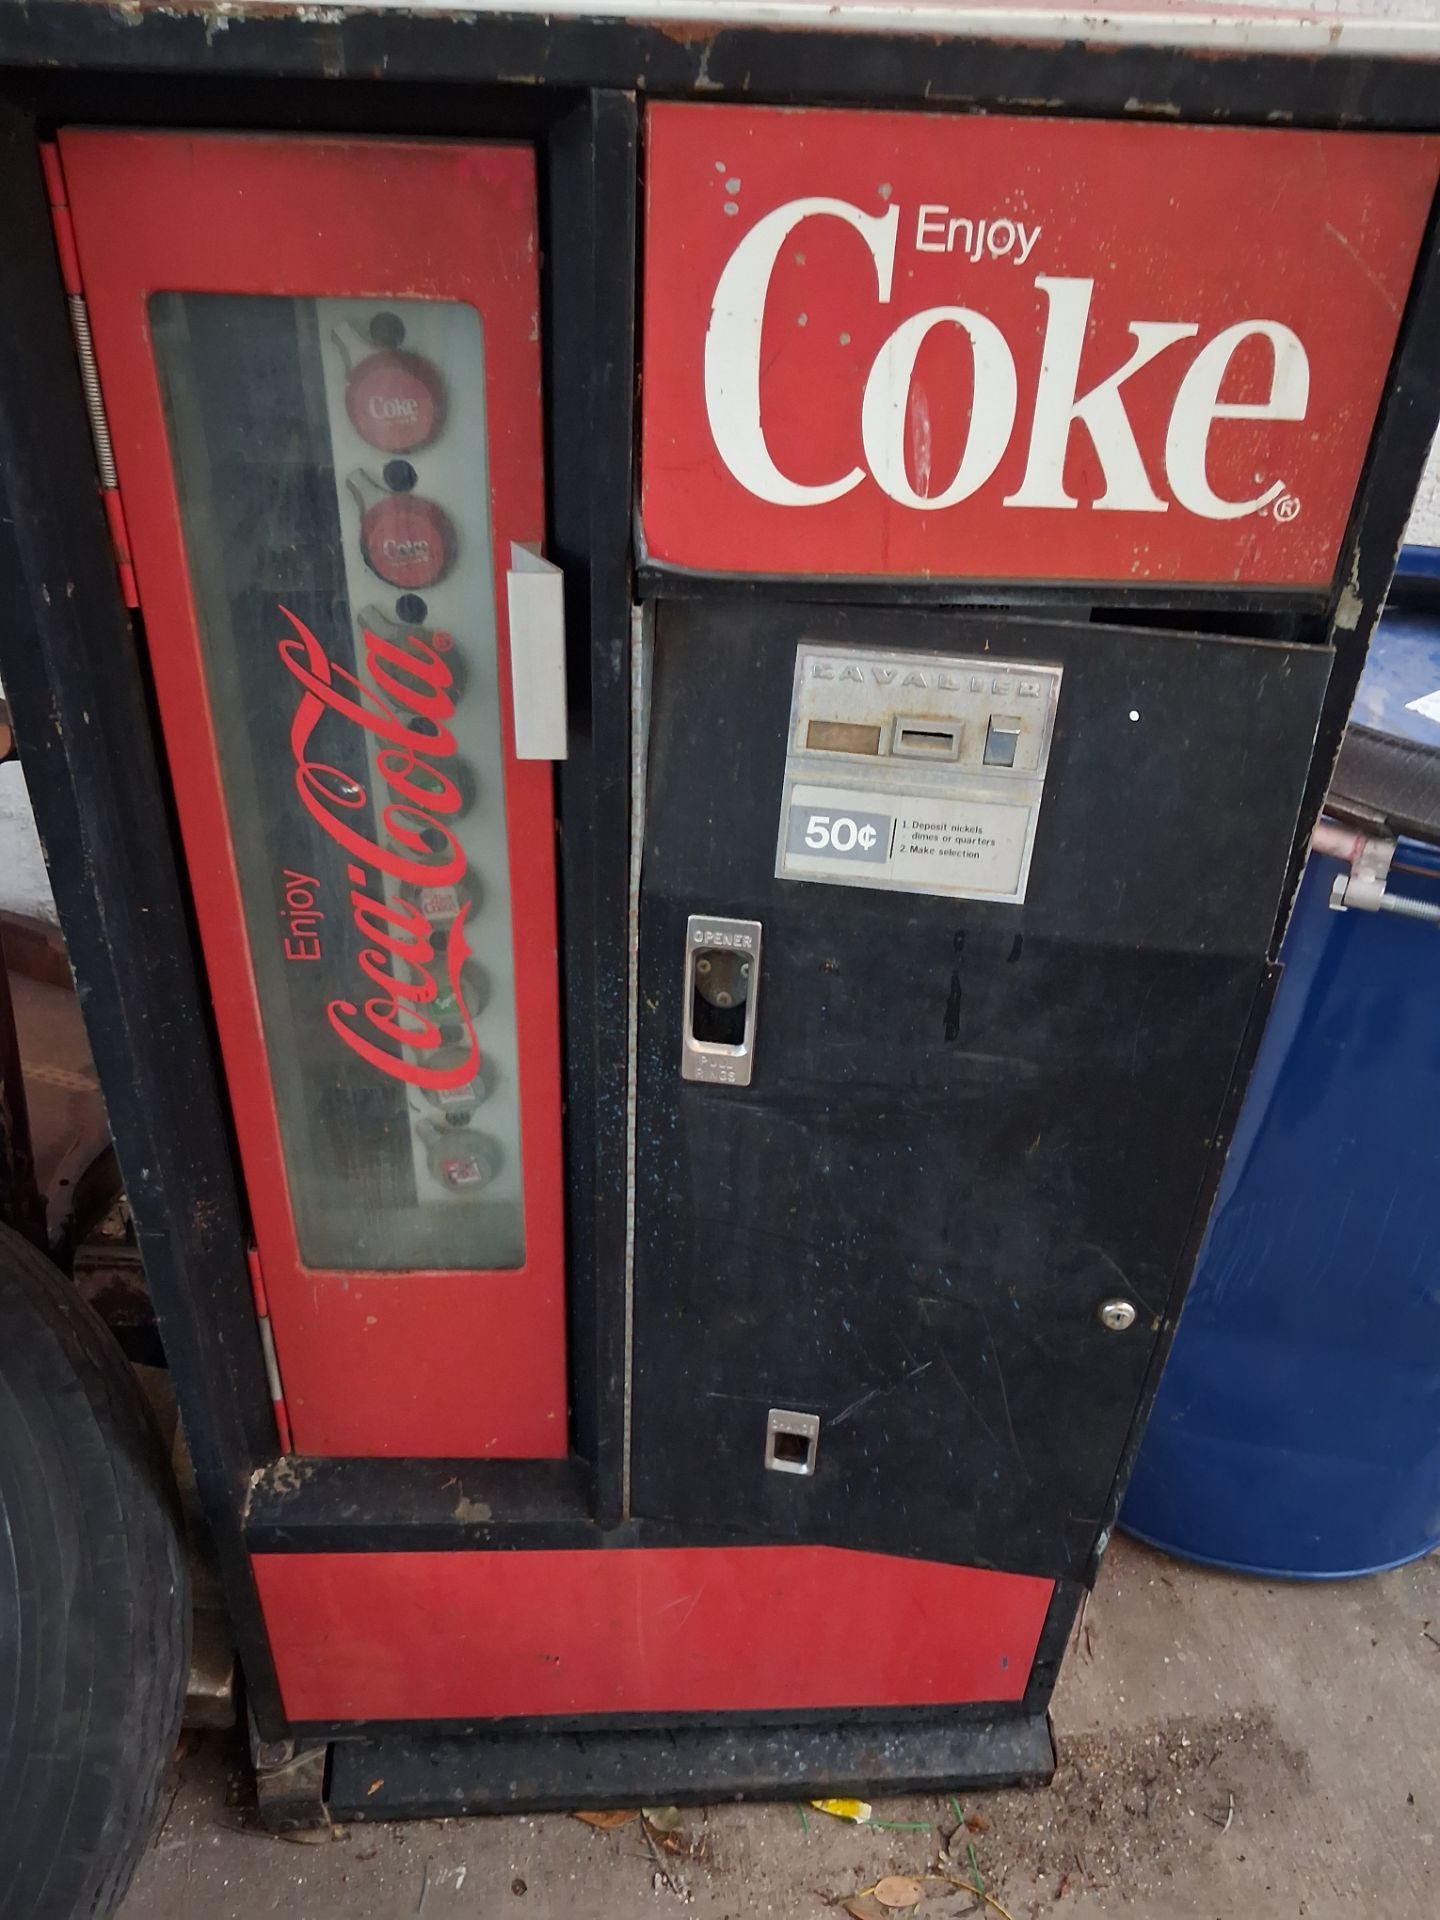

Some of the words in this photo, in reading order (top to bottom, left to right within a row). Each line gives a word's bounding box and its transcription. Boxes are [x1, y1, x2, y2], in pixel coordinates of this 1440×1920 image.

[915, 204, 1042, 265] Enjoy
[704, 196, 1310, 521] Coke
[368, 396, 418, 421] Coke
[803, 814, 878, 852] 50¢
[911, 831, 938, 842] dimes
[955, 836, 995, 846] quarters
[912, 820, 947, 831] Deposit
[951, 824, 983, 834] nickels
[909, 845, 934, 855] Make
[938, 848, 979, 859] selection
[282, 869, 325, 962] Enjoy
[693, 930, 753, 949] OPENER
